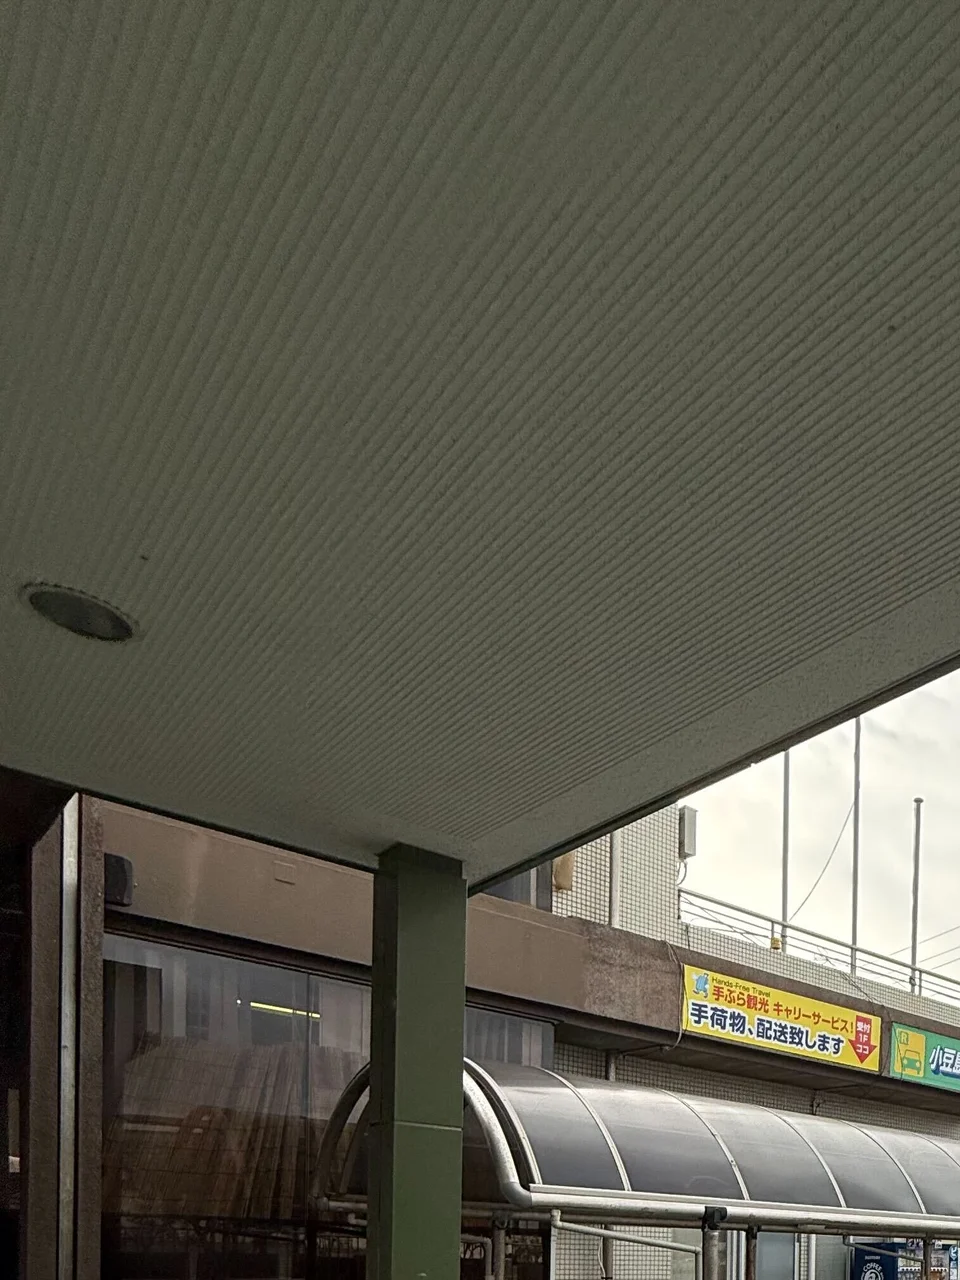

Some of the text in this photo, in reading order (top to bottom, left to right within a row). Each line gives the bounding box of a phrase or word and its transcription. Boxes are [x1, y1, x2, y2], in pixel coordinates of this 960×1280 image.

[711, 976, 771, 998] Hands-Free Travel
[712, 985, 770, 1014] 手ぶら観光
[690, 1002, 844, 1055] 手荷物、配送致します
[856, 1021, 871, 1034] 受付
[859, 1033, 869, 1043] 1F
[856, 1044, 870, 1055] ココ
